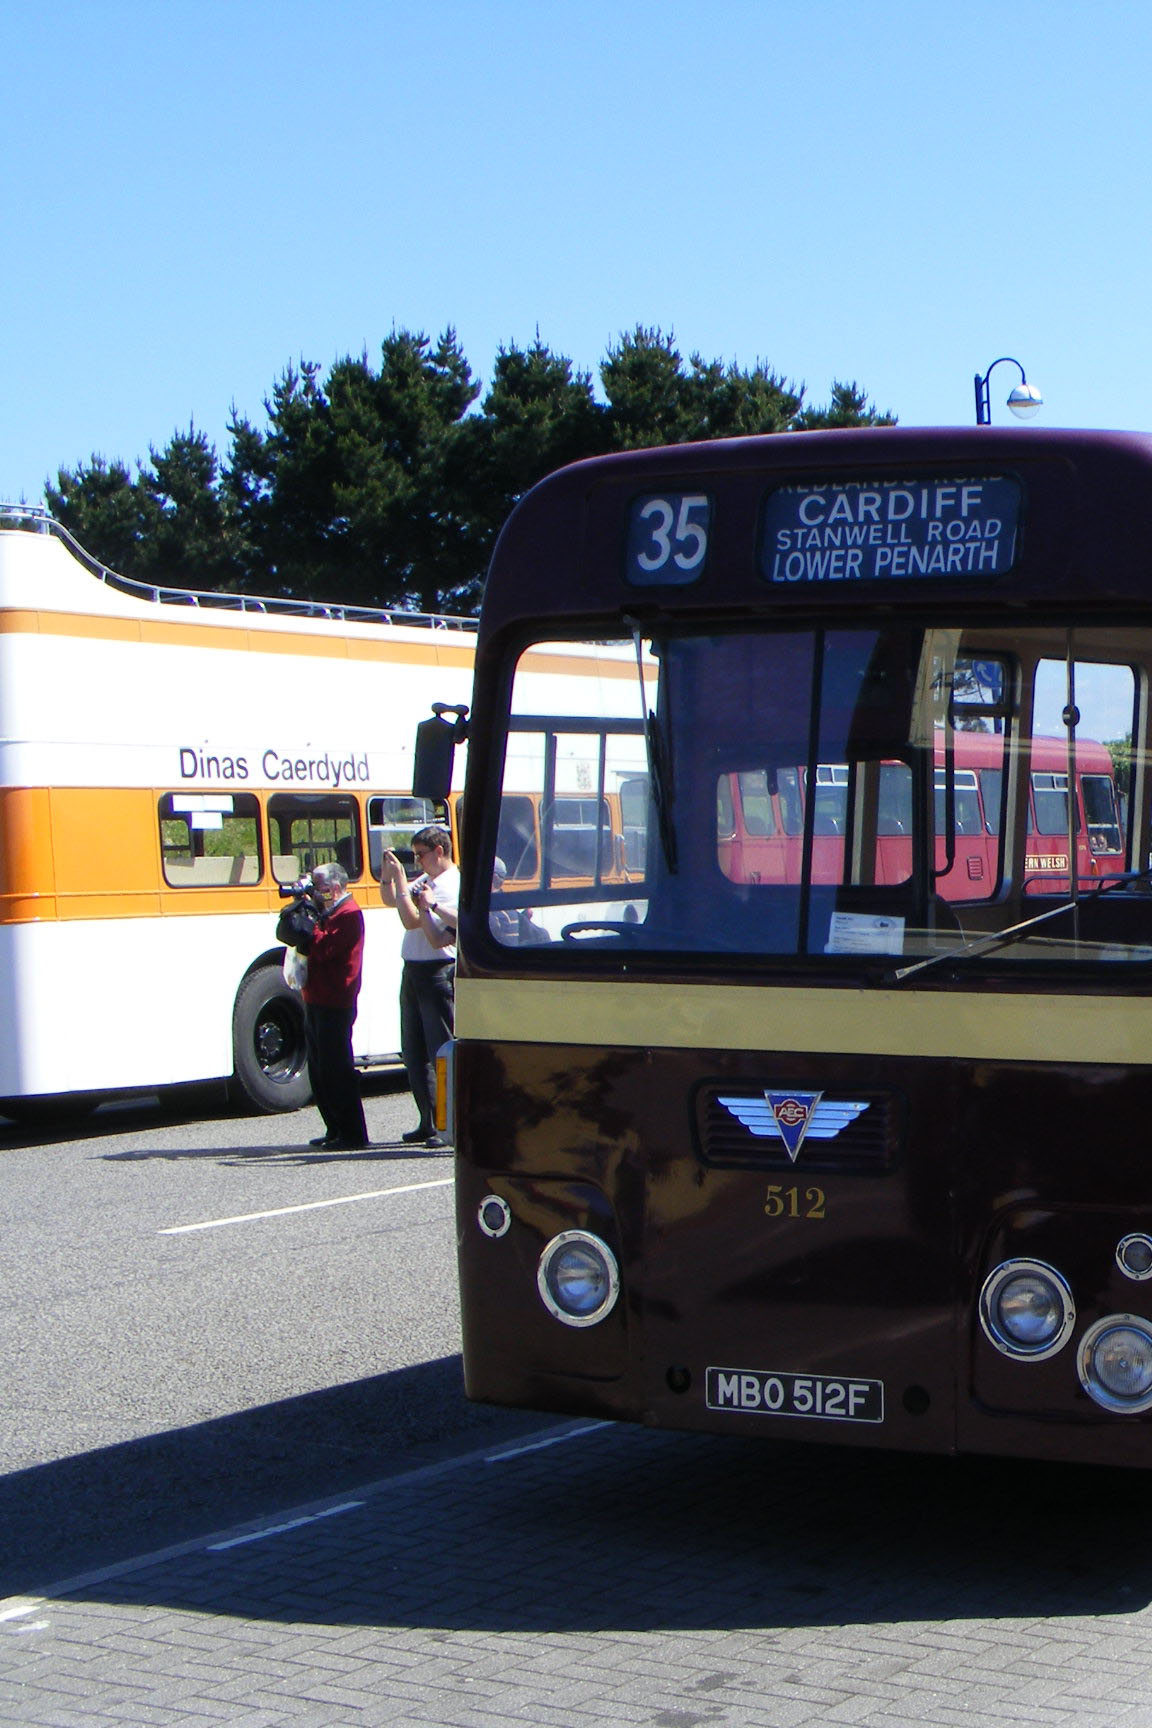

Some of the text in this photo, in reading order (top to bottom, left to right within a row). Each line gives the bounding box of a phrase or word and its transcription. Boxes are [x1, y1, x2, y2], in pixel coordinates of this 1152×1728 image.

[799, 486, 983, 526] CARDIFF
[637, 496, 708, 572] 35
[776, 519, 1002, 550] STANWELL ROAD
[773, 540, 999, 582] LOWER PENARTH
[179, 748, 370, 787] Dinas Caerdydd
[1040, 857, 1065, 869] WELSH
[779, 1107, 804, 1117] AEC
[764, 1185, 826, 1219] 512
[718, 1373, 870, 1416] MBO 512F
